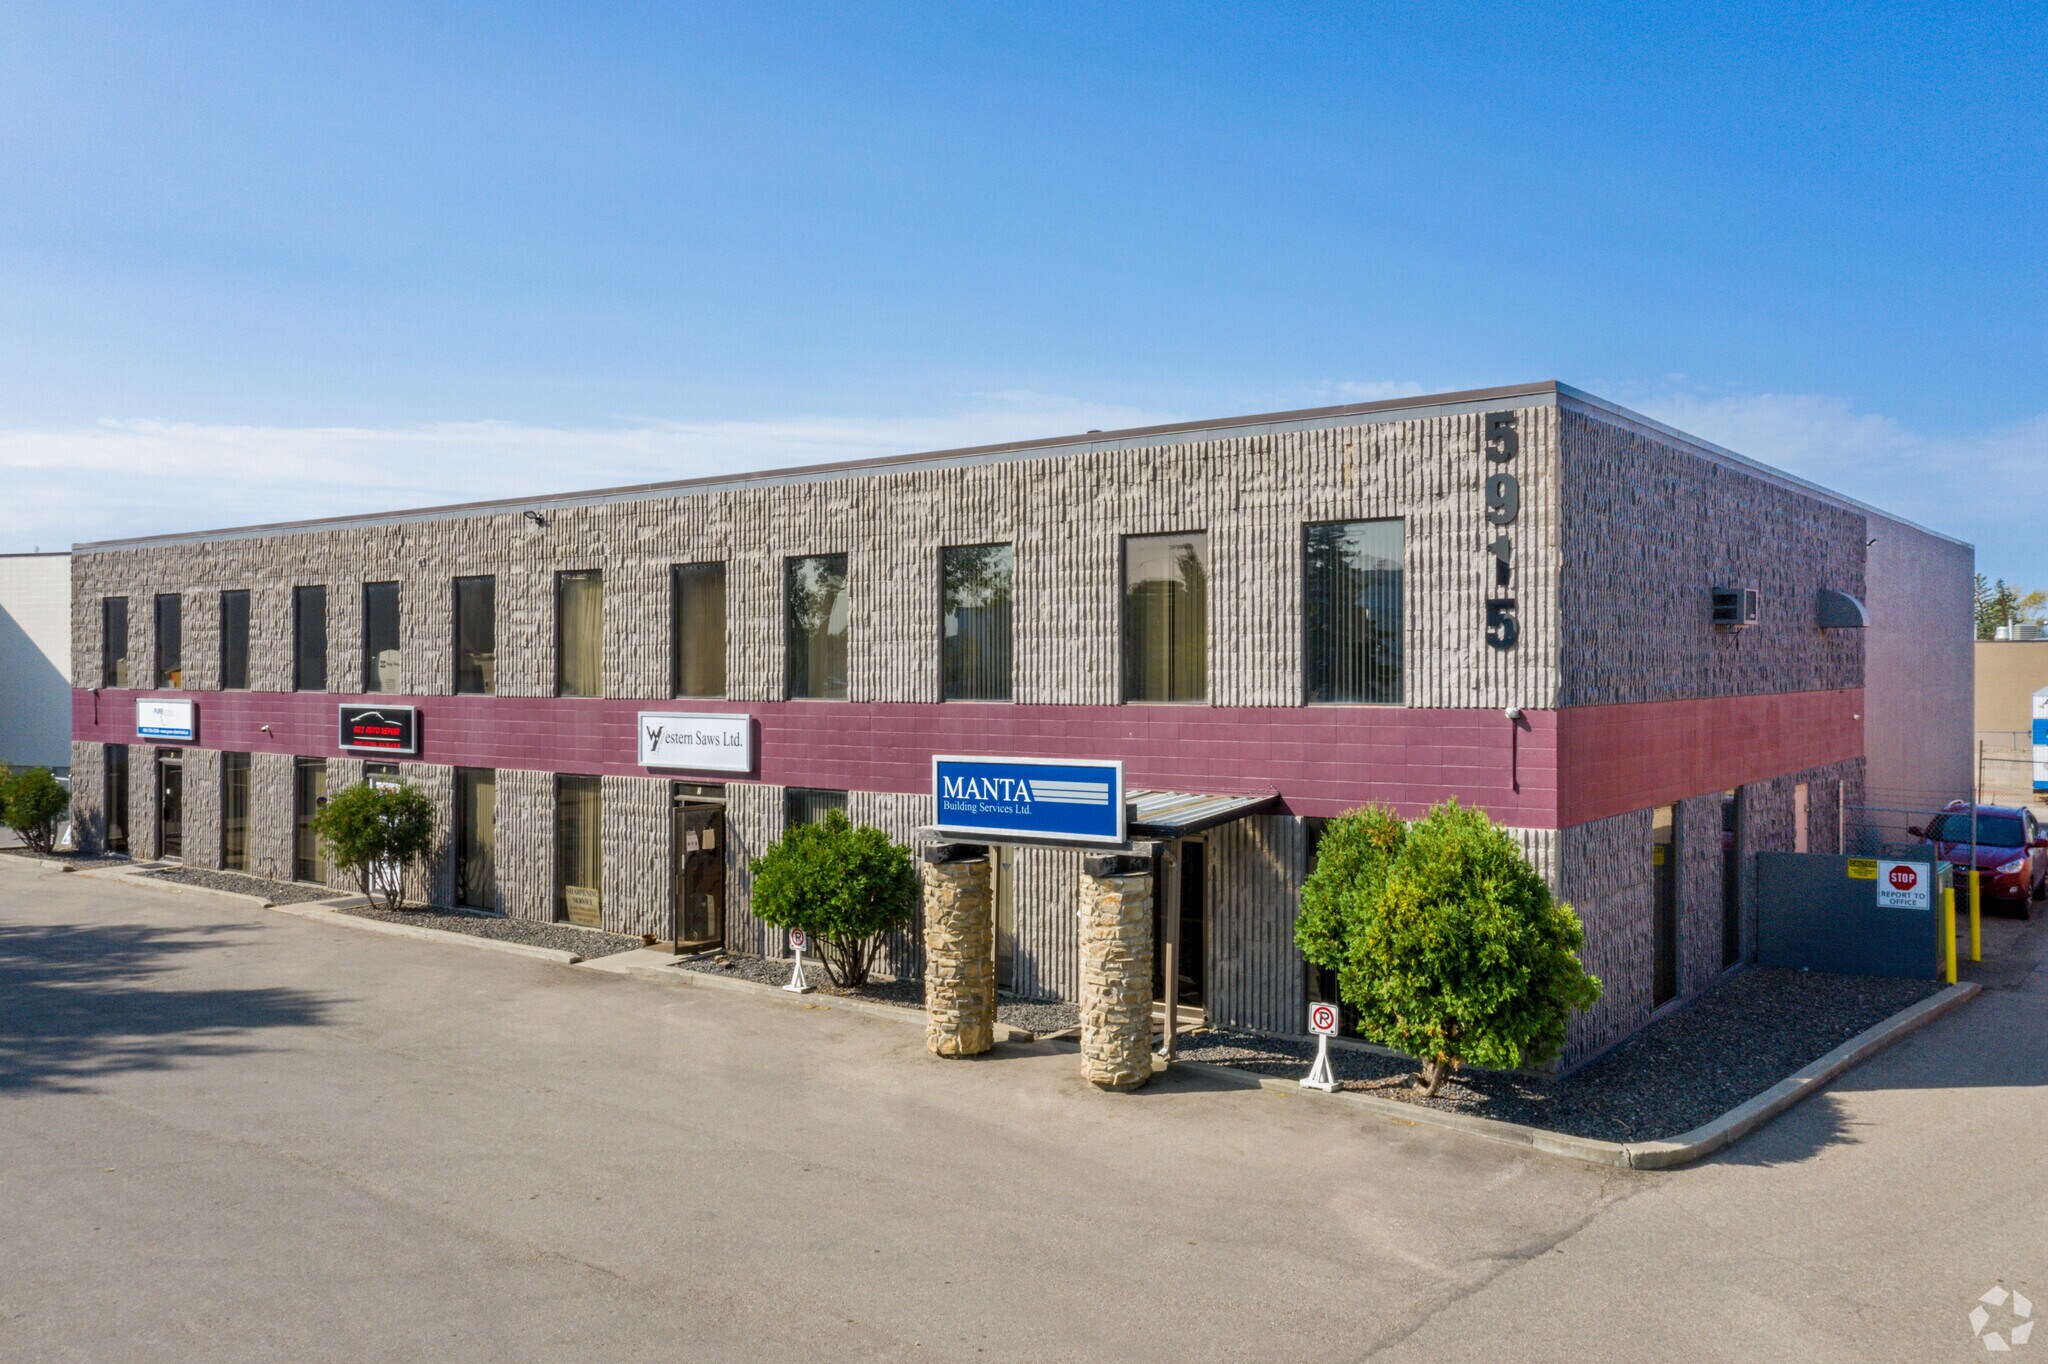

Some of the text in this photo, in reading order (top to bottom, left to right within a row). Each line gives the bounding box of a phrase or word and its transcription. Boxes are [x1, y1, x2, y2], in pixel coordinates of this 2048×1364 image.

[1485, 410, 1519, 651] 5915
[365, 726, 380, 735] AUTO
[380, 727, 401, 736] REPAIR
[695, 730, 720, 746] Saws
[723, 731, 743, 747] Ltd.
[943, 776, 1031, 802] MANTA
[944, 801, 1032, 815] Building Services Ltd.
[1891, 872, 1915, 883] STOP
[566, 887, 599, 898] SHARPENING
[1914, 892, 1926, 900] TO
